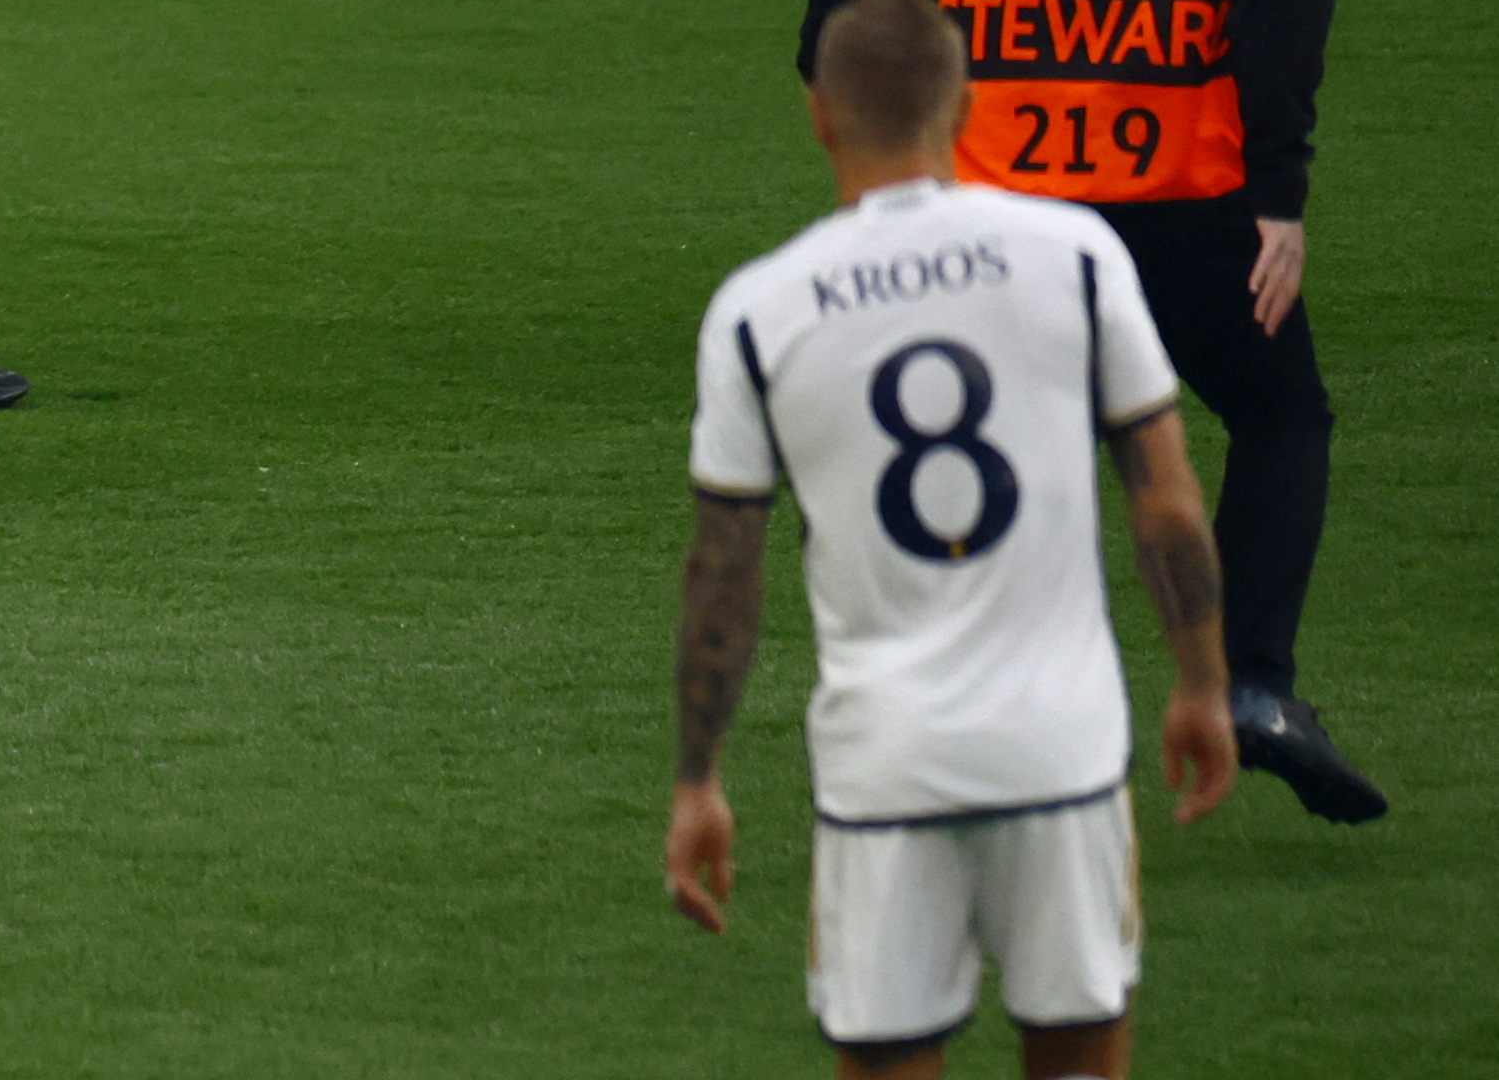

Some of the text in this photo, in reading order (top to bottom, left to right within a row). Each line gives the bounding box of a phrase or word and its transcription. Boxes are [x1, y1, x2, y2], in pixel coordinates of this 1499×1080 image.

[1009, 105, 1160, 177] 219
[812, 239, 1008, 312] KROOS
[868, 336, 1019, 561] 8
